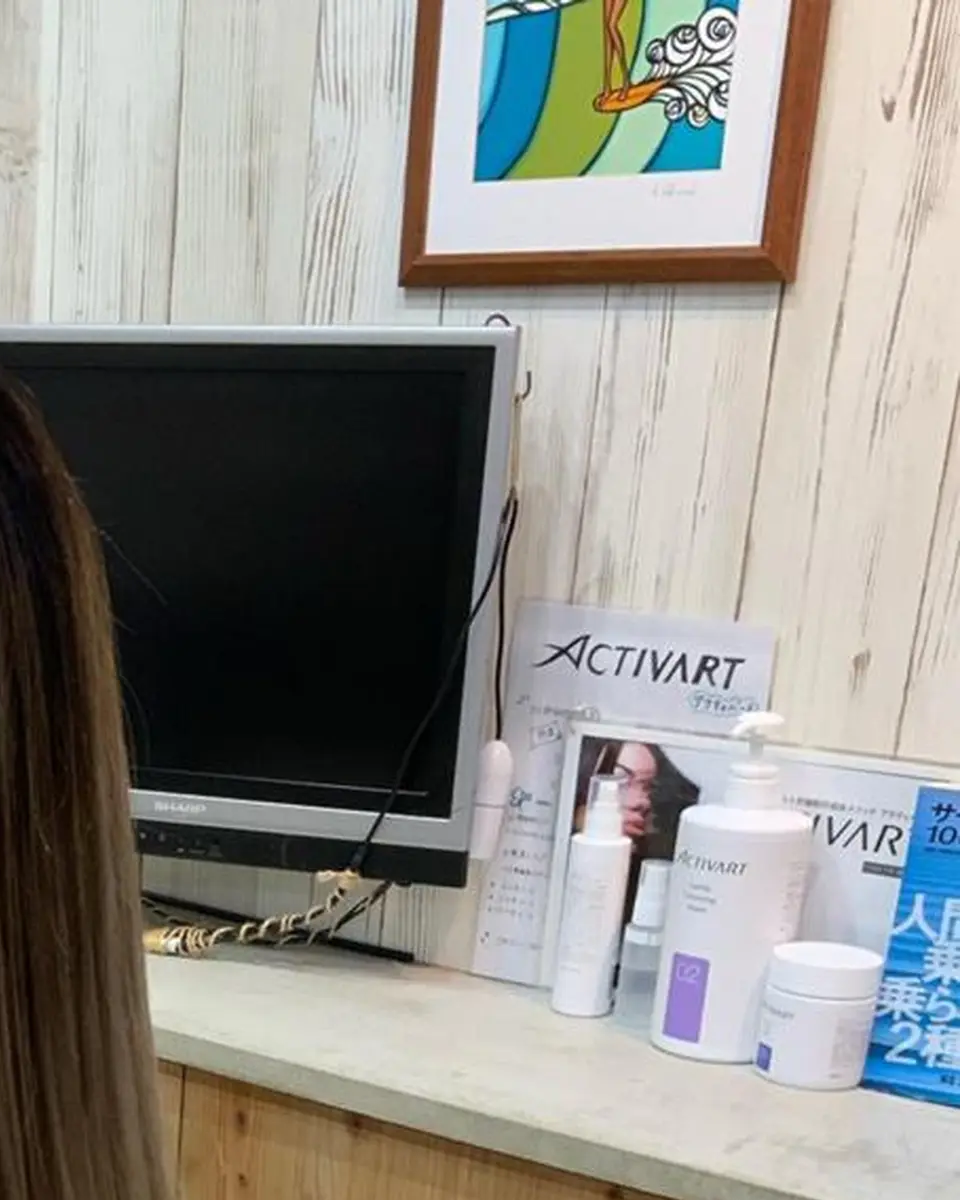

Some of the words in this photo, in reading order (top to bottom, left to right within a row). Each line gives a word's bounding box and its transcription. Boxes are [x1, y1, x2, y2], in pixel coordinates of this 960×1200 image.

[532, 634, 746, 690] ACTIVART
[931, 803, 960, 823] サ
[803, 811, 904, 857] IVAR
[677, 850, 748, 876] ACTIVART
